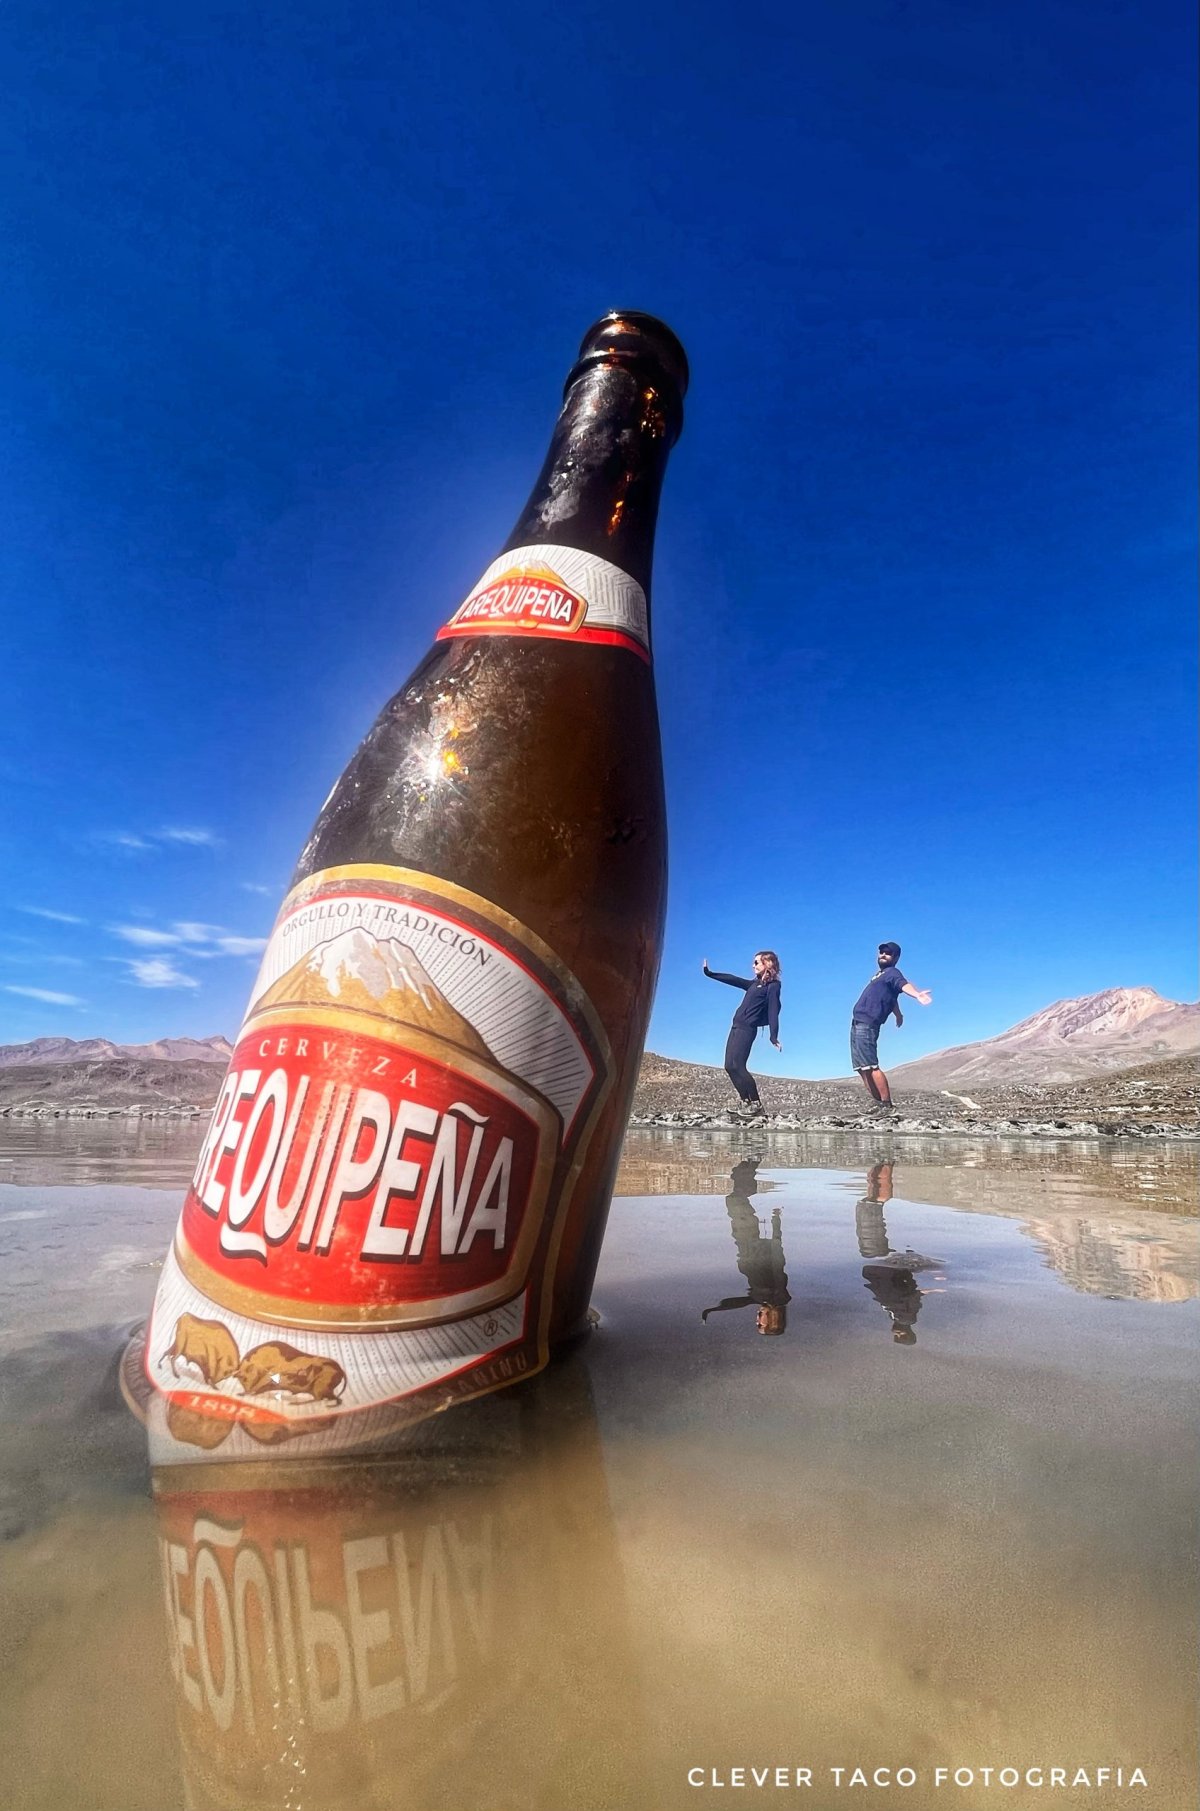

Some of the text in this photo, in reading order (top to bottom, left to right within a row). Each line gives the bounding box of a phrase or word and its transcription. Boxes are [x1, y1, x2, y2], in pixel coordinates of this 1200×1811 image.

[460, 585, 573, 622] AREQUIPEÑA
[282, 902, 493, 967] ORGULLO Y TRADICIÓN
[258, 1038, 418, 1088] CERVEZA
[192, 1067, 514, 1266] REQUIPEÑA
